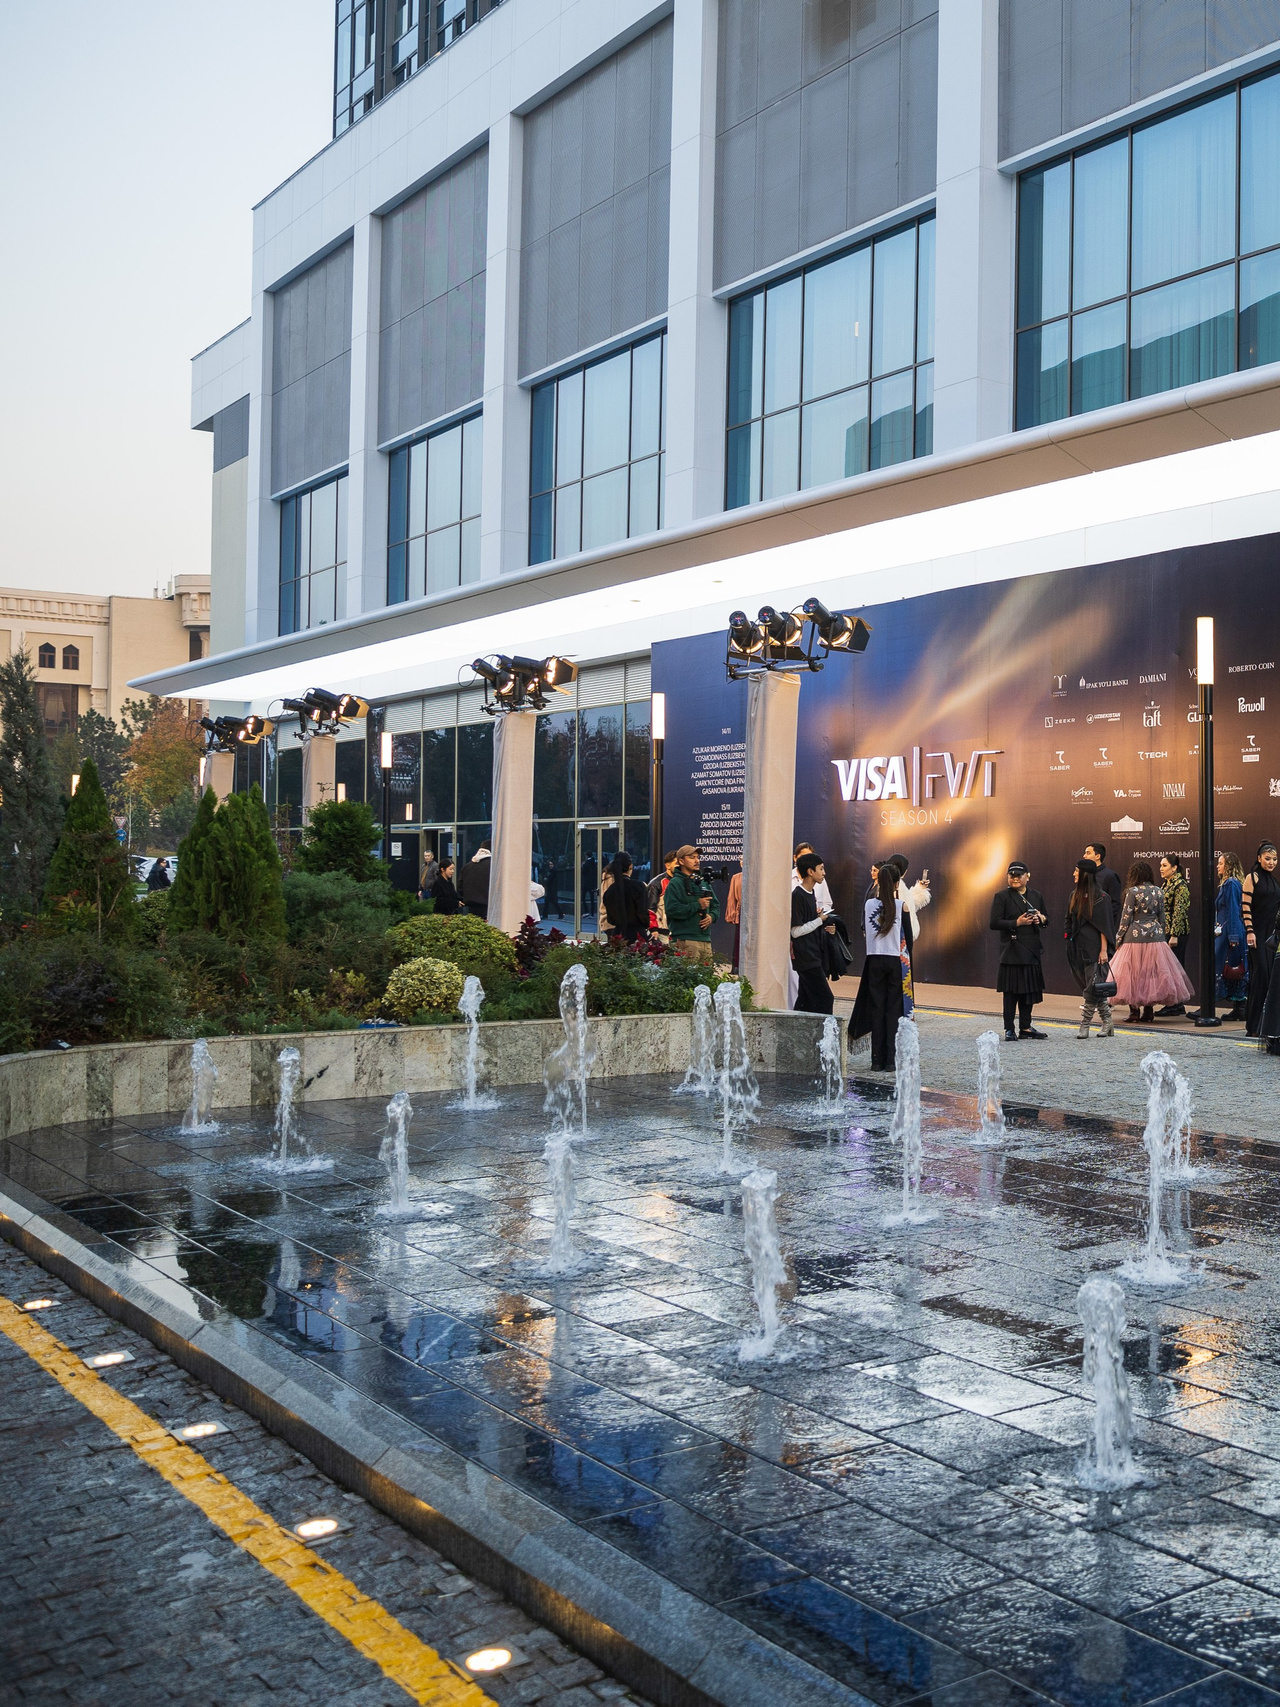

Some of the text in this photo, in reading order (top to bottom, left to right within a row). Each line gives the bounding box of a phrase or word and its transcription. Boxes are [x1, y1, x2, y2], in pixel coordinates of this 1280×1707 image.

[1228, 662, 1275, 673] ROBERTO COIN
[1112, 679, 1129, 687] BANKI
[1139, 673, 1167, 684] DAMIANI
[1238, 697, 1265, 713] Perwoll
[1143, 709, 1162, 727] taft
[691, 771, 709, 779] AZAMAT
[831, 756, 908, 801] VISA
[1163, 783, 1185, 798] NNAM
[880, 809, 953, 826] SEASON 4
